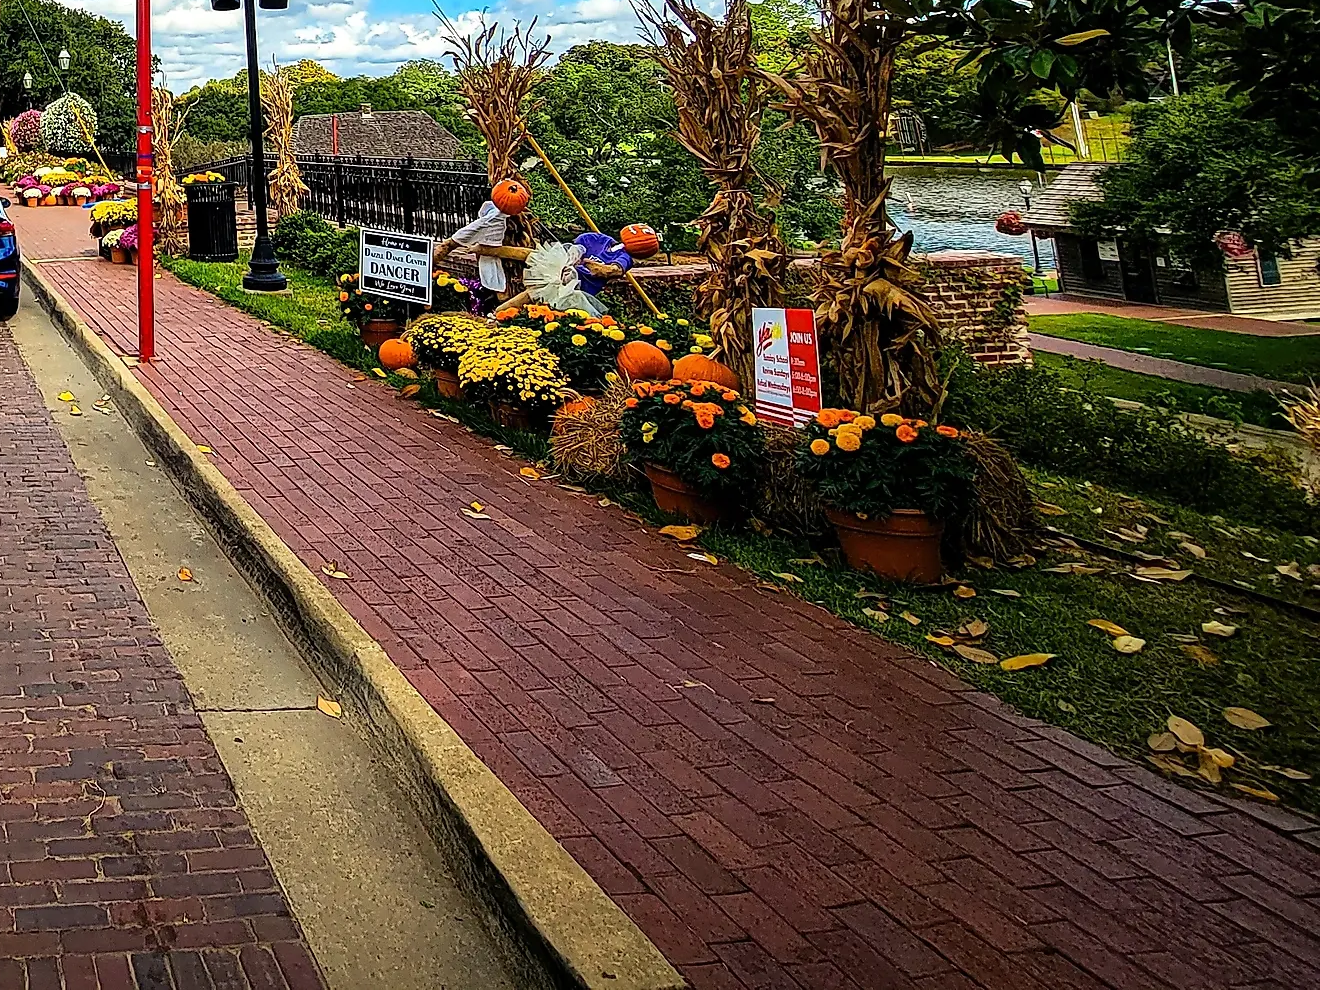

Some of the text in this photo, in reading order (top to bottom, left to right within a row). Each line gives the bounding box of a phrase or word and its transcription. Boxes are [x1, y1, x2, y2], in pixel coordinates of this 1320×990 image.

[381, 237, 397, 246] Home
[370, 262, 420, 282] DANCER
[375, 280, 385, 288] We
[789, 332, 812, 344] JOIN US
